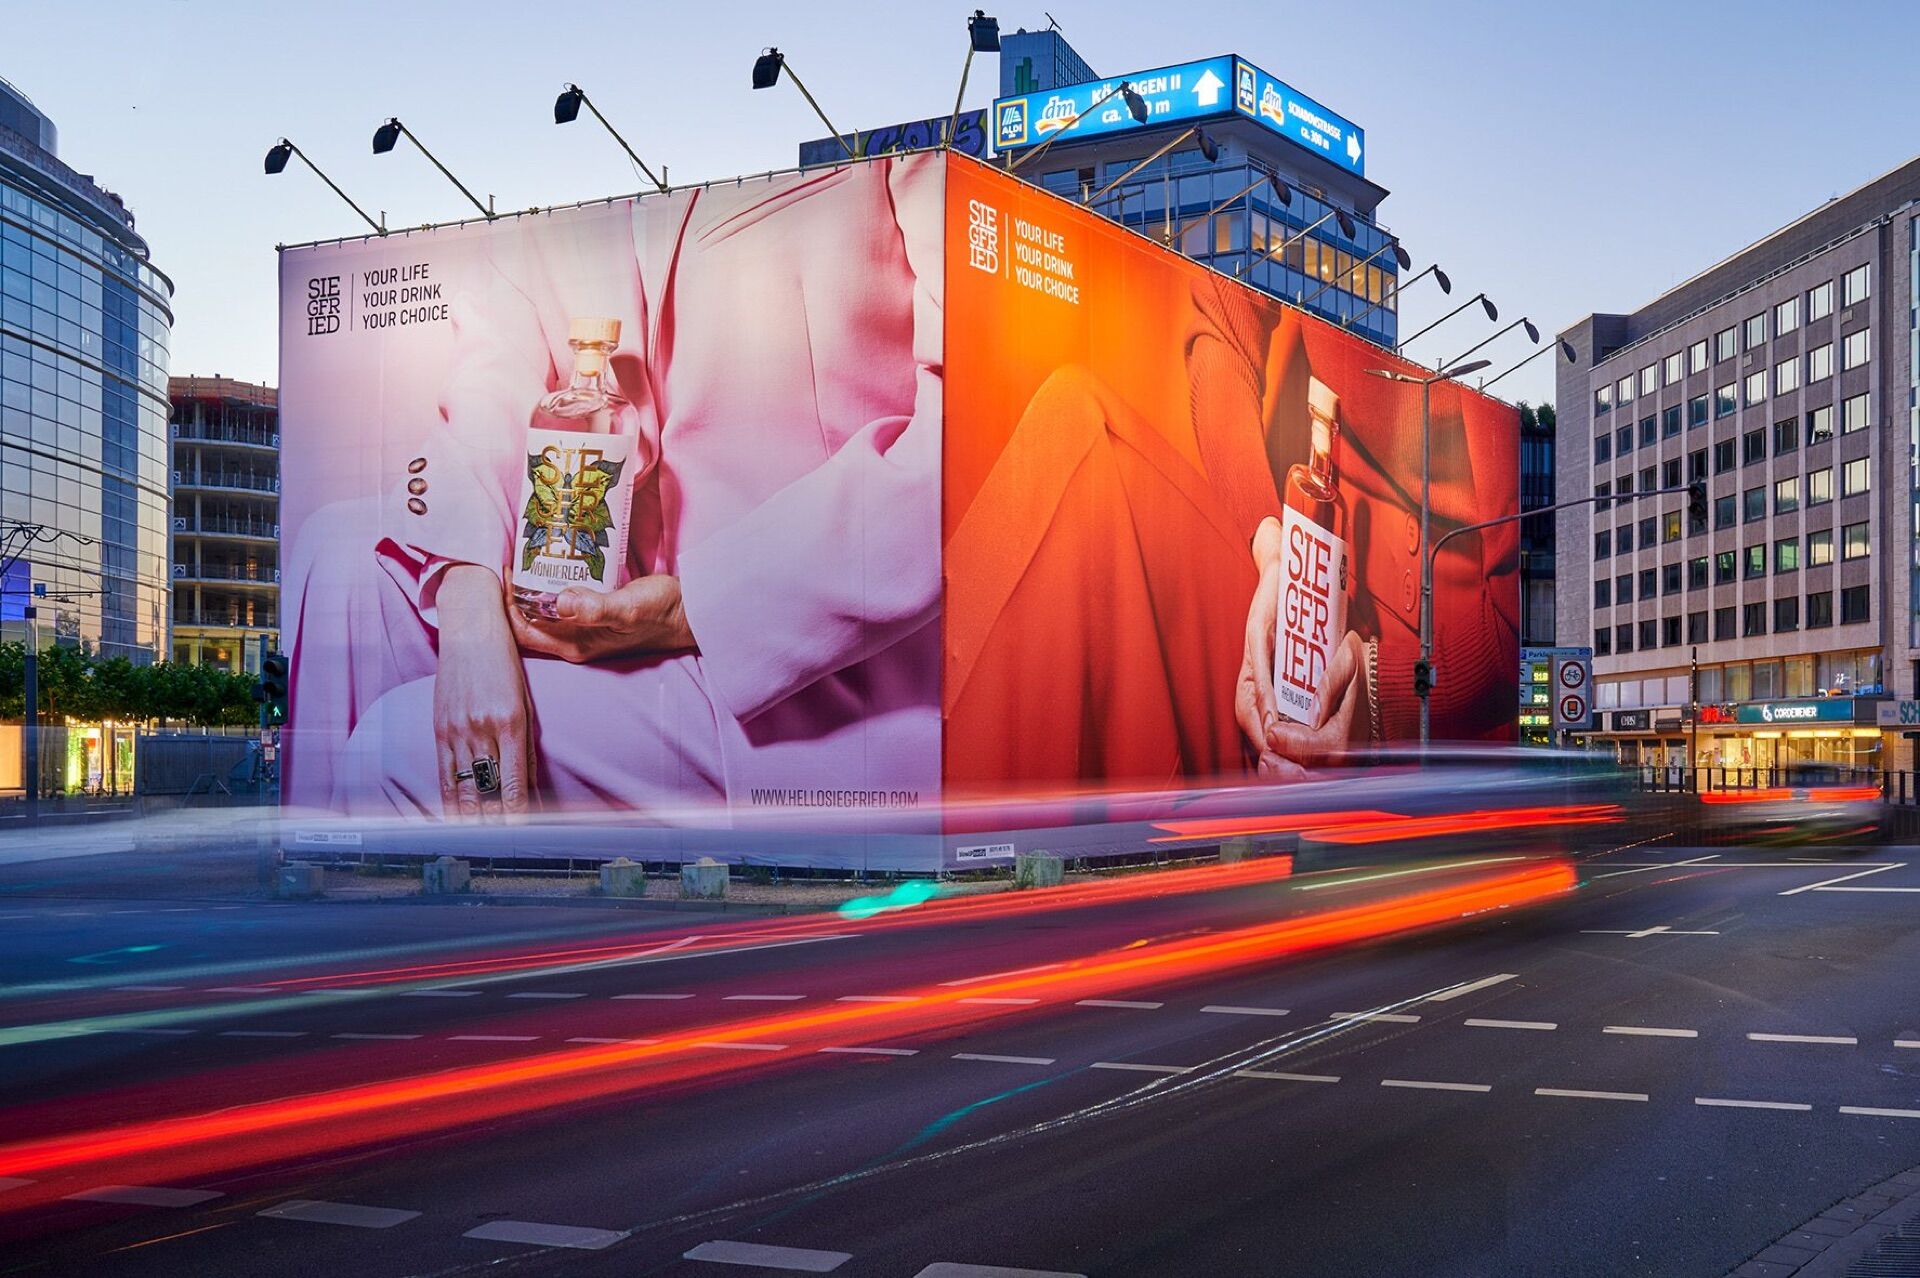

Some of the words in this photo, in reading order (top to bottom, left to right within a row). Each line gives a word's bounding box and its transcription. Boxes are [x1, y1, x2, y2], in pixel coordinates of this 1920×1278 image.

[1170, 74, 1181, 91] II
[1042, 95, 1077, 121] dm
[1102, 109, 1122, 124] ca.
[1155, 99, 1171, 114] m
[1001, 123, 1023, 135] ALDI
[969, 198, 998, 233] SIE
[968, 224, 999, 253] GFR
[1014, 217, 1042, 246] YOUR
[1043, 229, 1065, 254] LIFE
[969, 243, 999, 275] IED
[1014, 241, 1043, 269] YOUR
[1043, 253, 1074, 280] DRINK
[308, 276, 341, 299] SIE
[363, 267, 398, 287] YOUR
[401, 263, 430, 282] LIFE
[1014, 265, 1043, 292] YOUR
[1043, 276, 1080, 305] CHOICE
[307, 297, 341, 316] GFR
[363, 289, 397, 308] YOUR
[401, 283, 442, 304] DRINK
[307, 315, 341, 336] IED
[362, 311, 397, 330] YOUR
[400, 304, 449, 325] CHOICE
[540, 444, 605, 489] SIE
[530, 561, 591, 582] WONDERLEAF
[1288, 523, 1332, 599] SIE
[1284, 581, 1329, 646] GFR
[1281, 628, 1327, 695] IED
[750, 788, 919, 809] WWW.HELLOSIEGFRIED.COM
